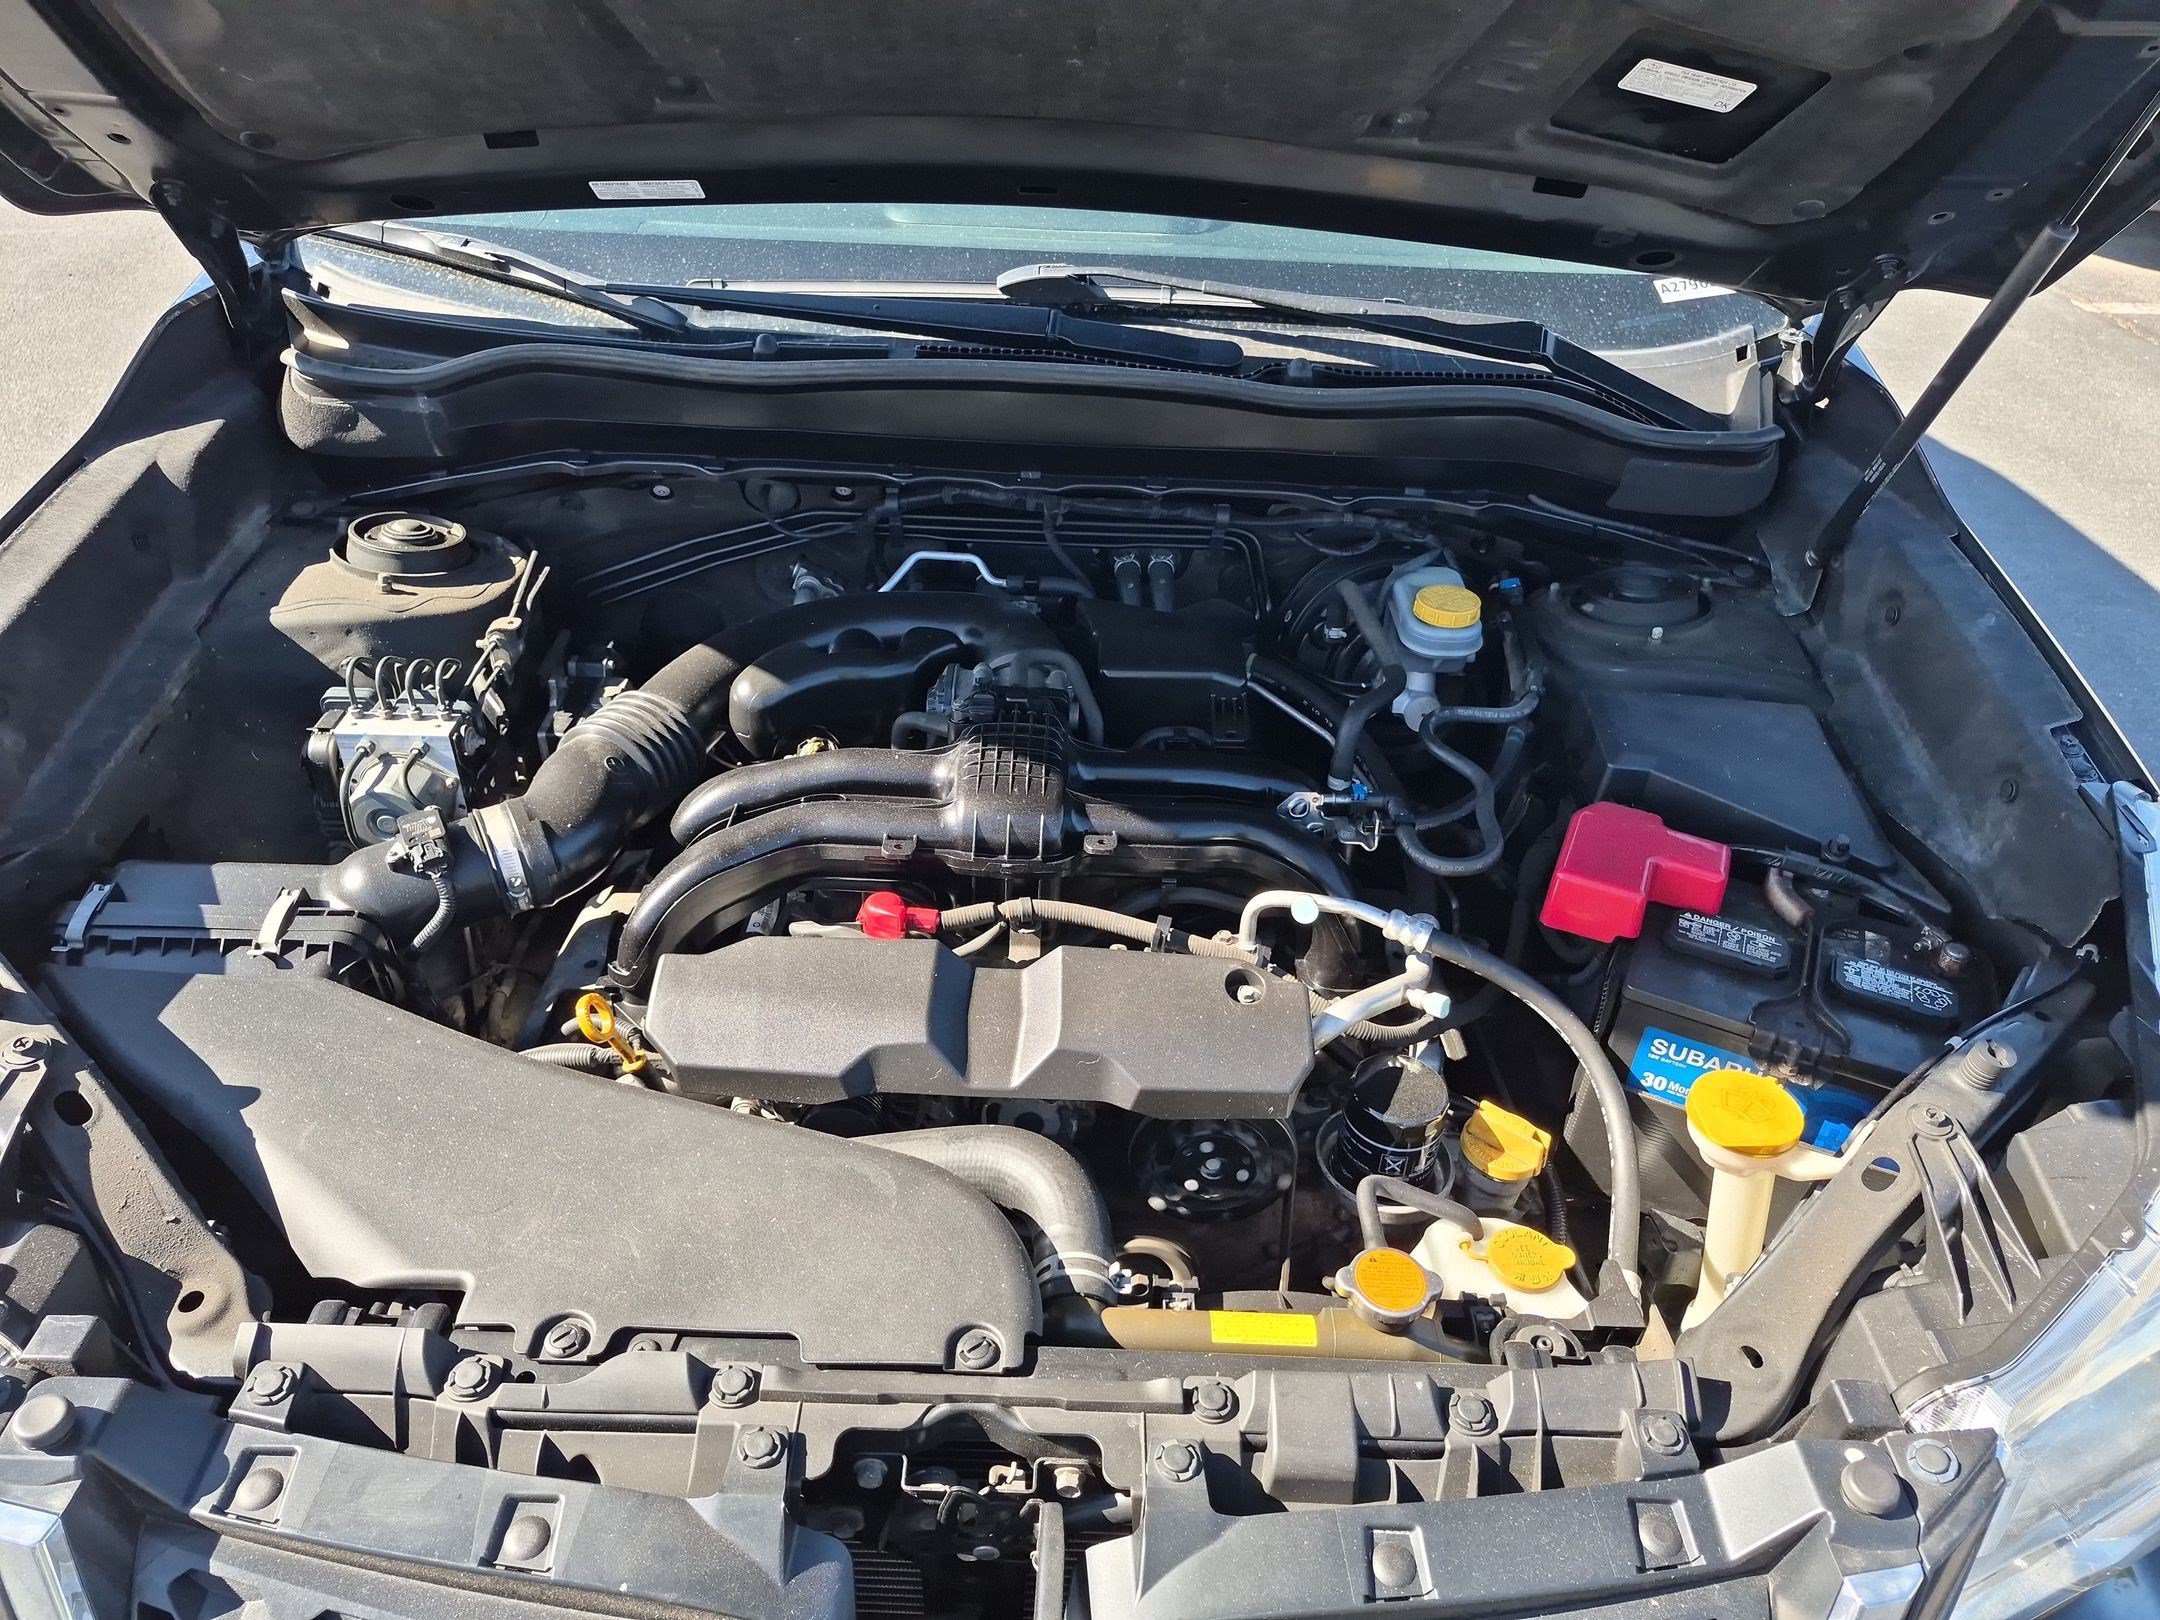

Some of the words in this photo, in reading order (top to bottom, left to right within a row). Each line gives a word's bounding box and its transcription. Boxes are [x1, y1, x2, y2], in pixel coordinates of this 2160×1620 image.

[1693, 914, 1731, 930] DANGER
[1741, 927, 1776, 943] POISON
[1660, 1057, 1687, 1069] BATTERY
[1640, 1071, 1668, 1092] 30
[1493, 1228, 1551, 1249] COOLANT
